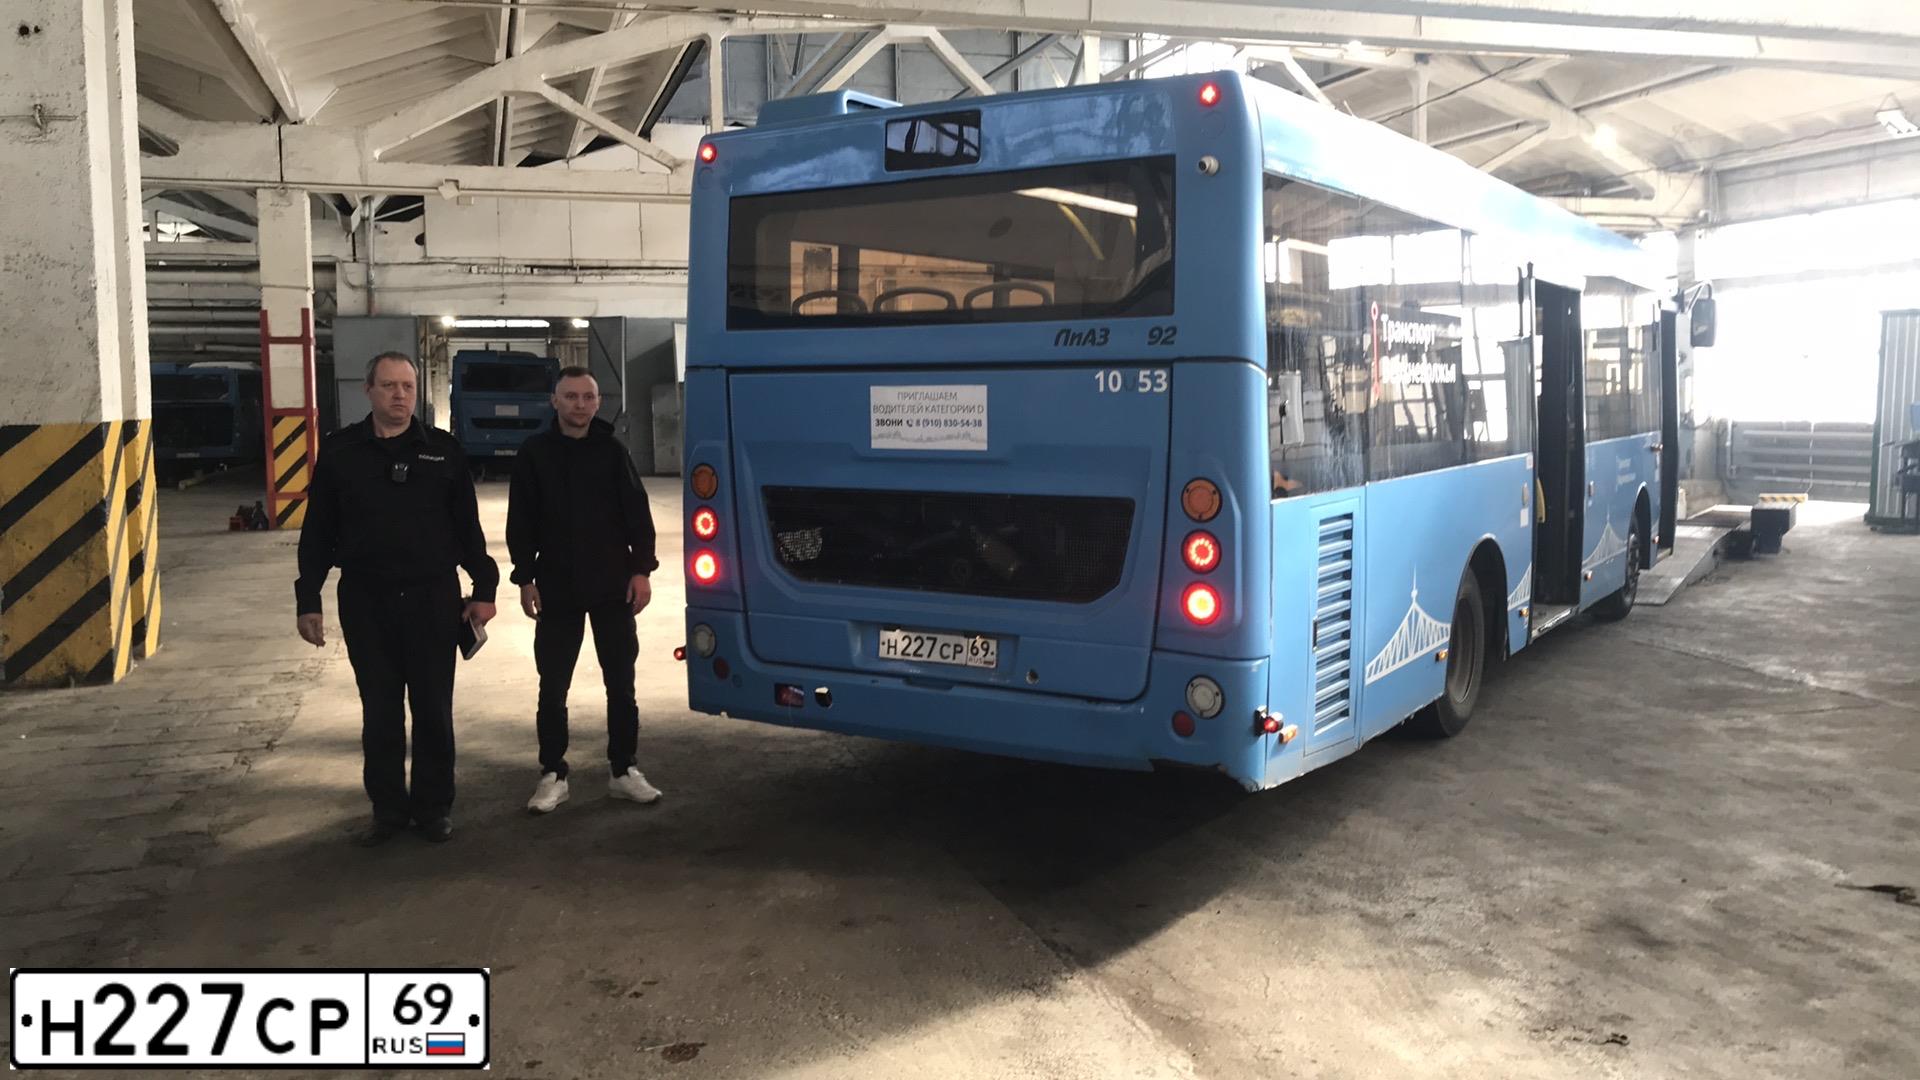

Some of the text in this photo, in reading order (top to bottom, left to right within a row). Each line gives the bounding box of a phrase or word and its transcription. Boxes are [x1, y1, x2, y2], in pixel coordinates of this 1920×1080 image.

[1147, 326, 1177, 346] 92
[897, 391, 958, 401] ПРИГЛАШАЕМ
[873, 403, 984, 415] ВОДИТЕЛЕЙ КАТЕГОРИИ D
[875, 418, 903, 427] ЗВОНИ
[922, 418, 942, 428] (910)
[970, 640, 990, 658] 69
